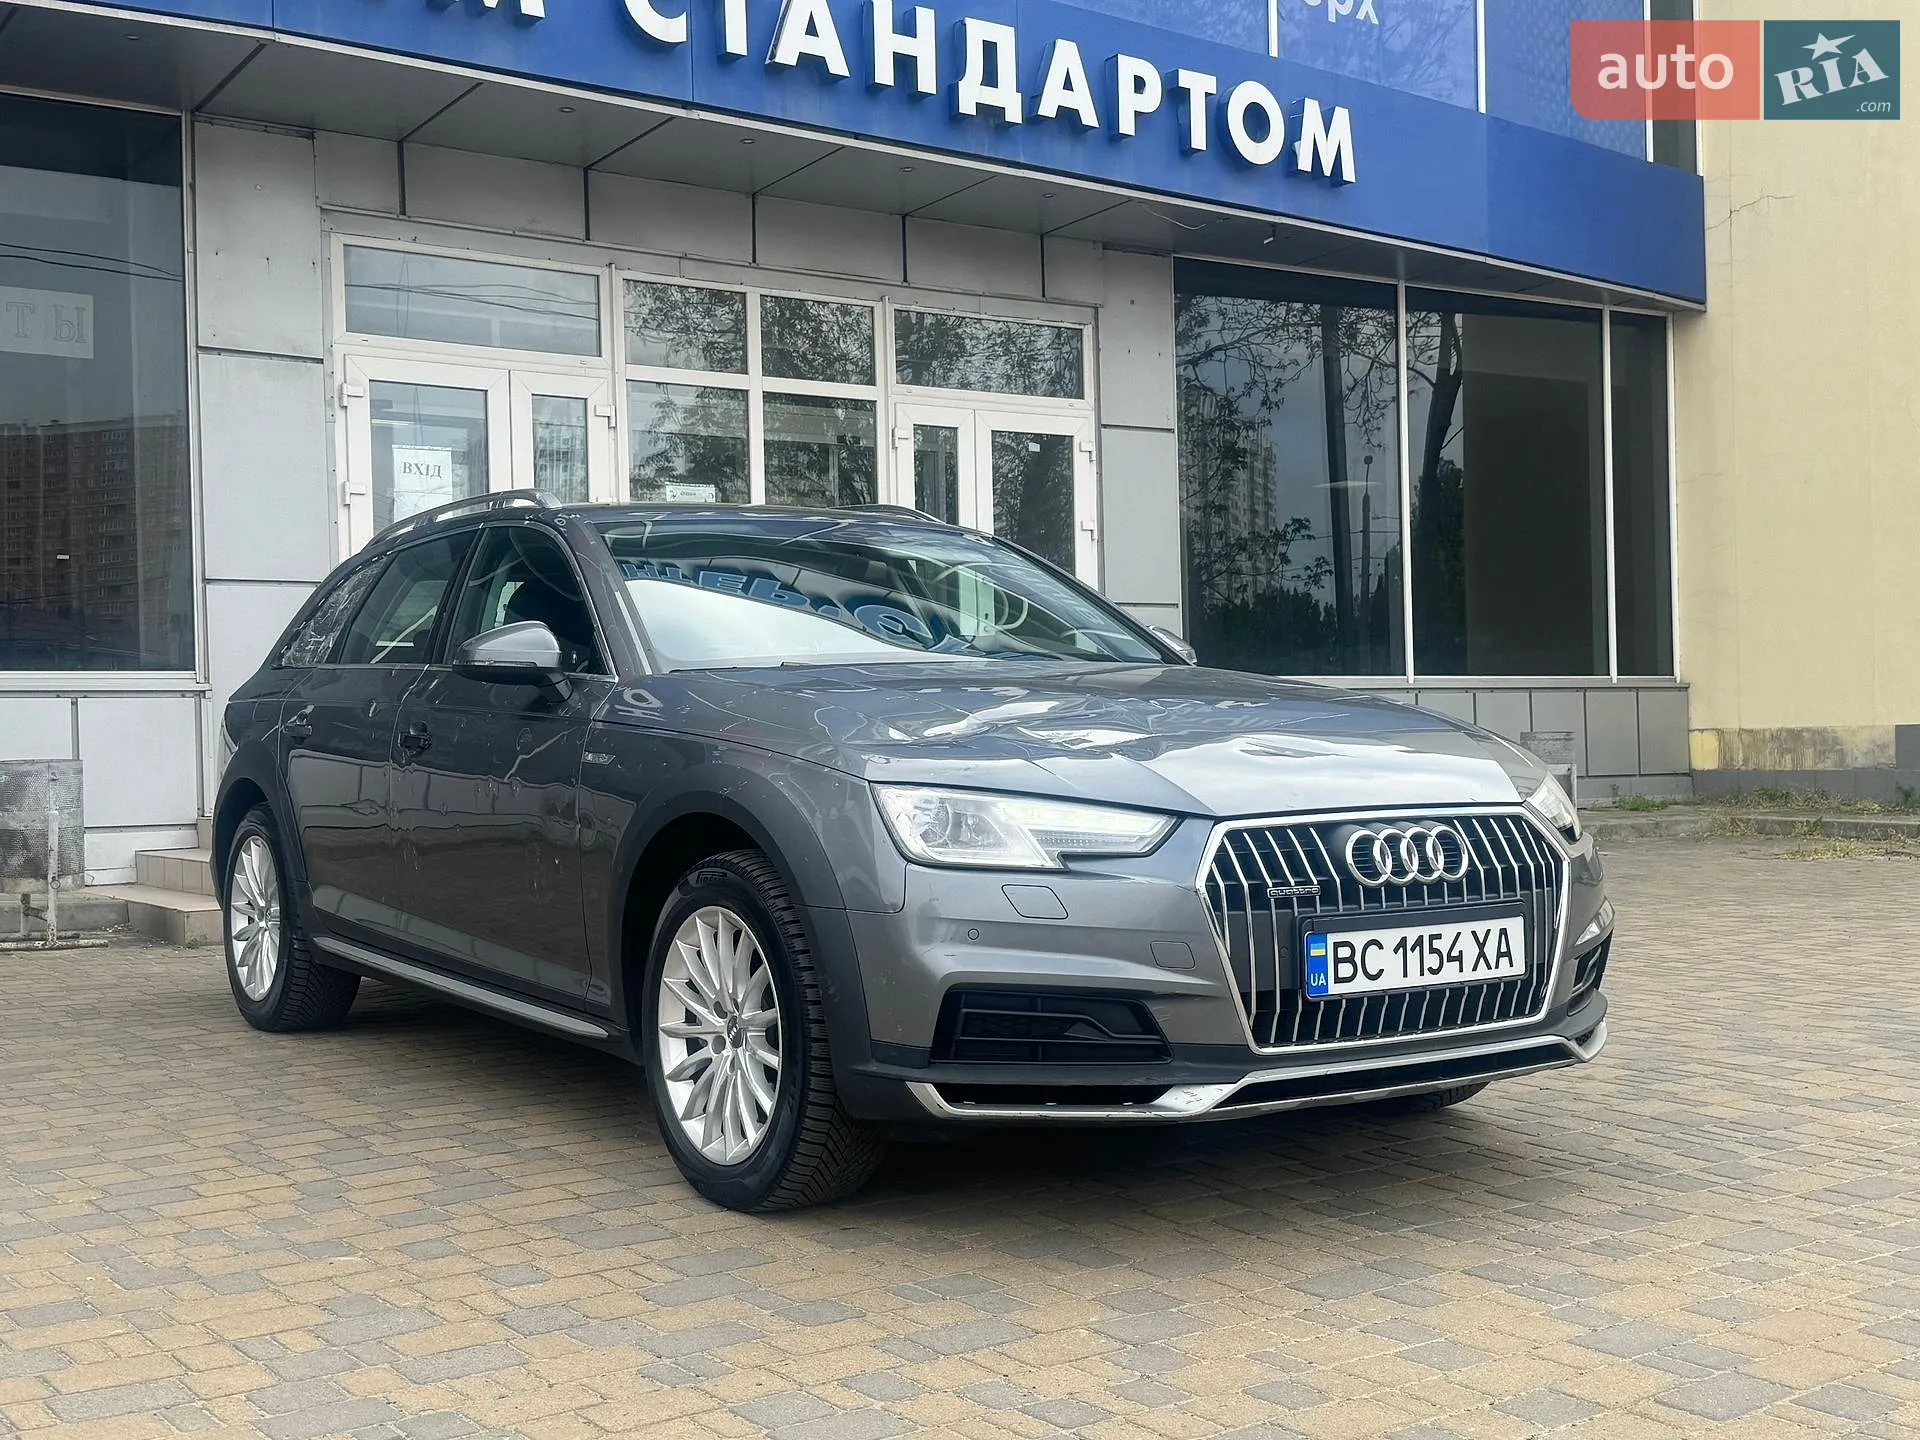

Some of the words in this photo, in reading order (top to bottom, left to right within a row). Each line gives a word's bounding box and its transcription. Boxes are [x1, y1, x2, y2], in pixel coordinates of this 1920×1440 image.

[1269, 887, 1319, 898] quattro
[1393, 931, 1464, 979] 1154
[1310, 972, 1327, 988] UA
